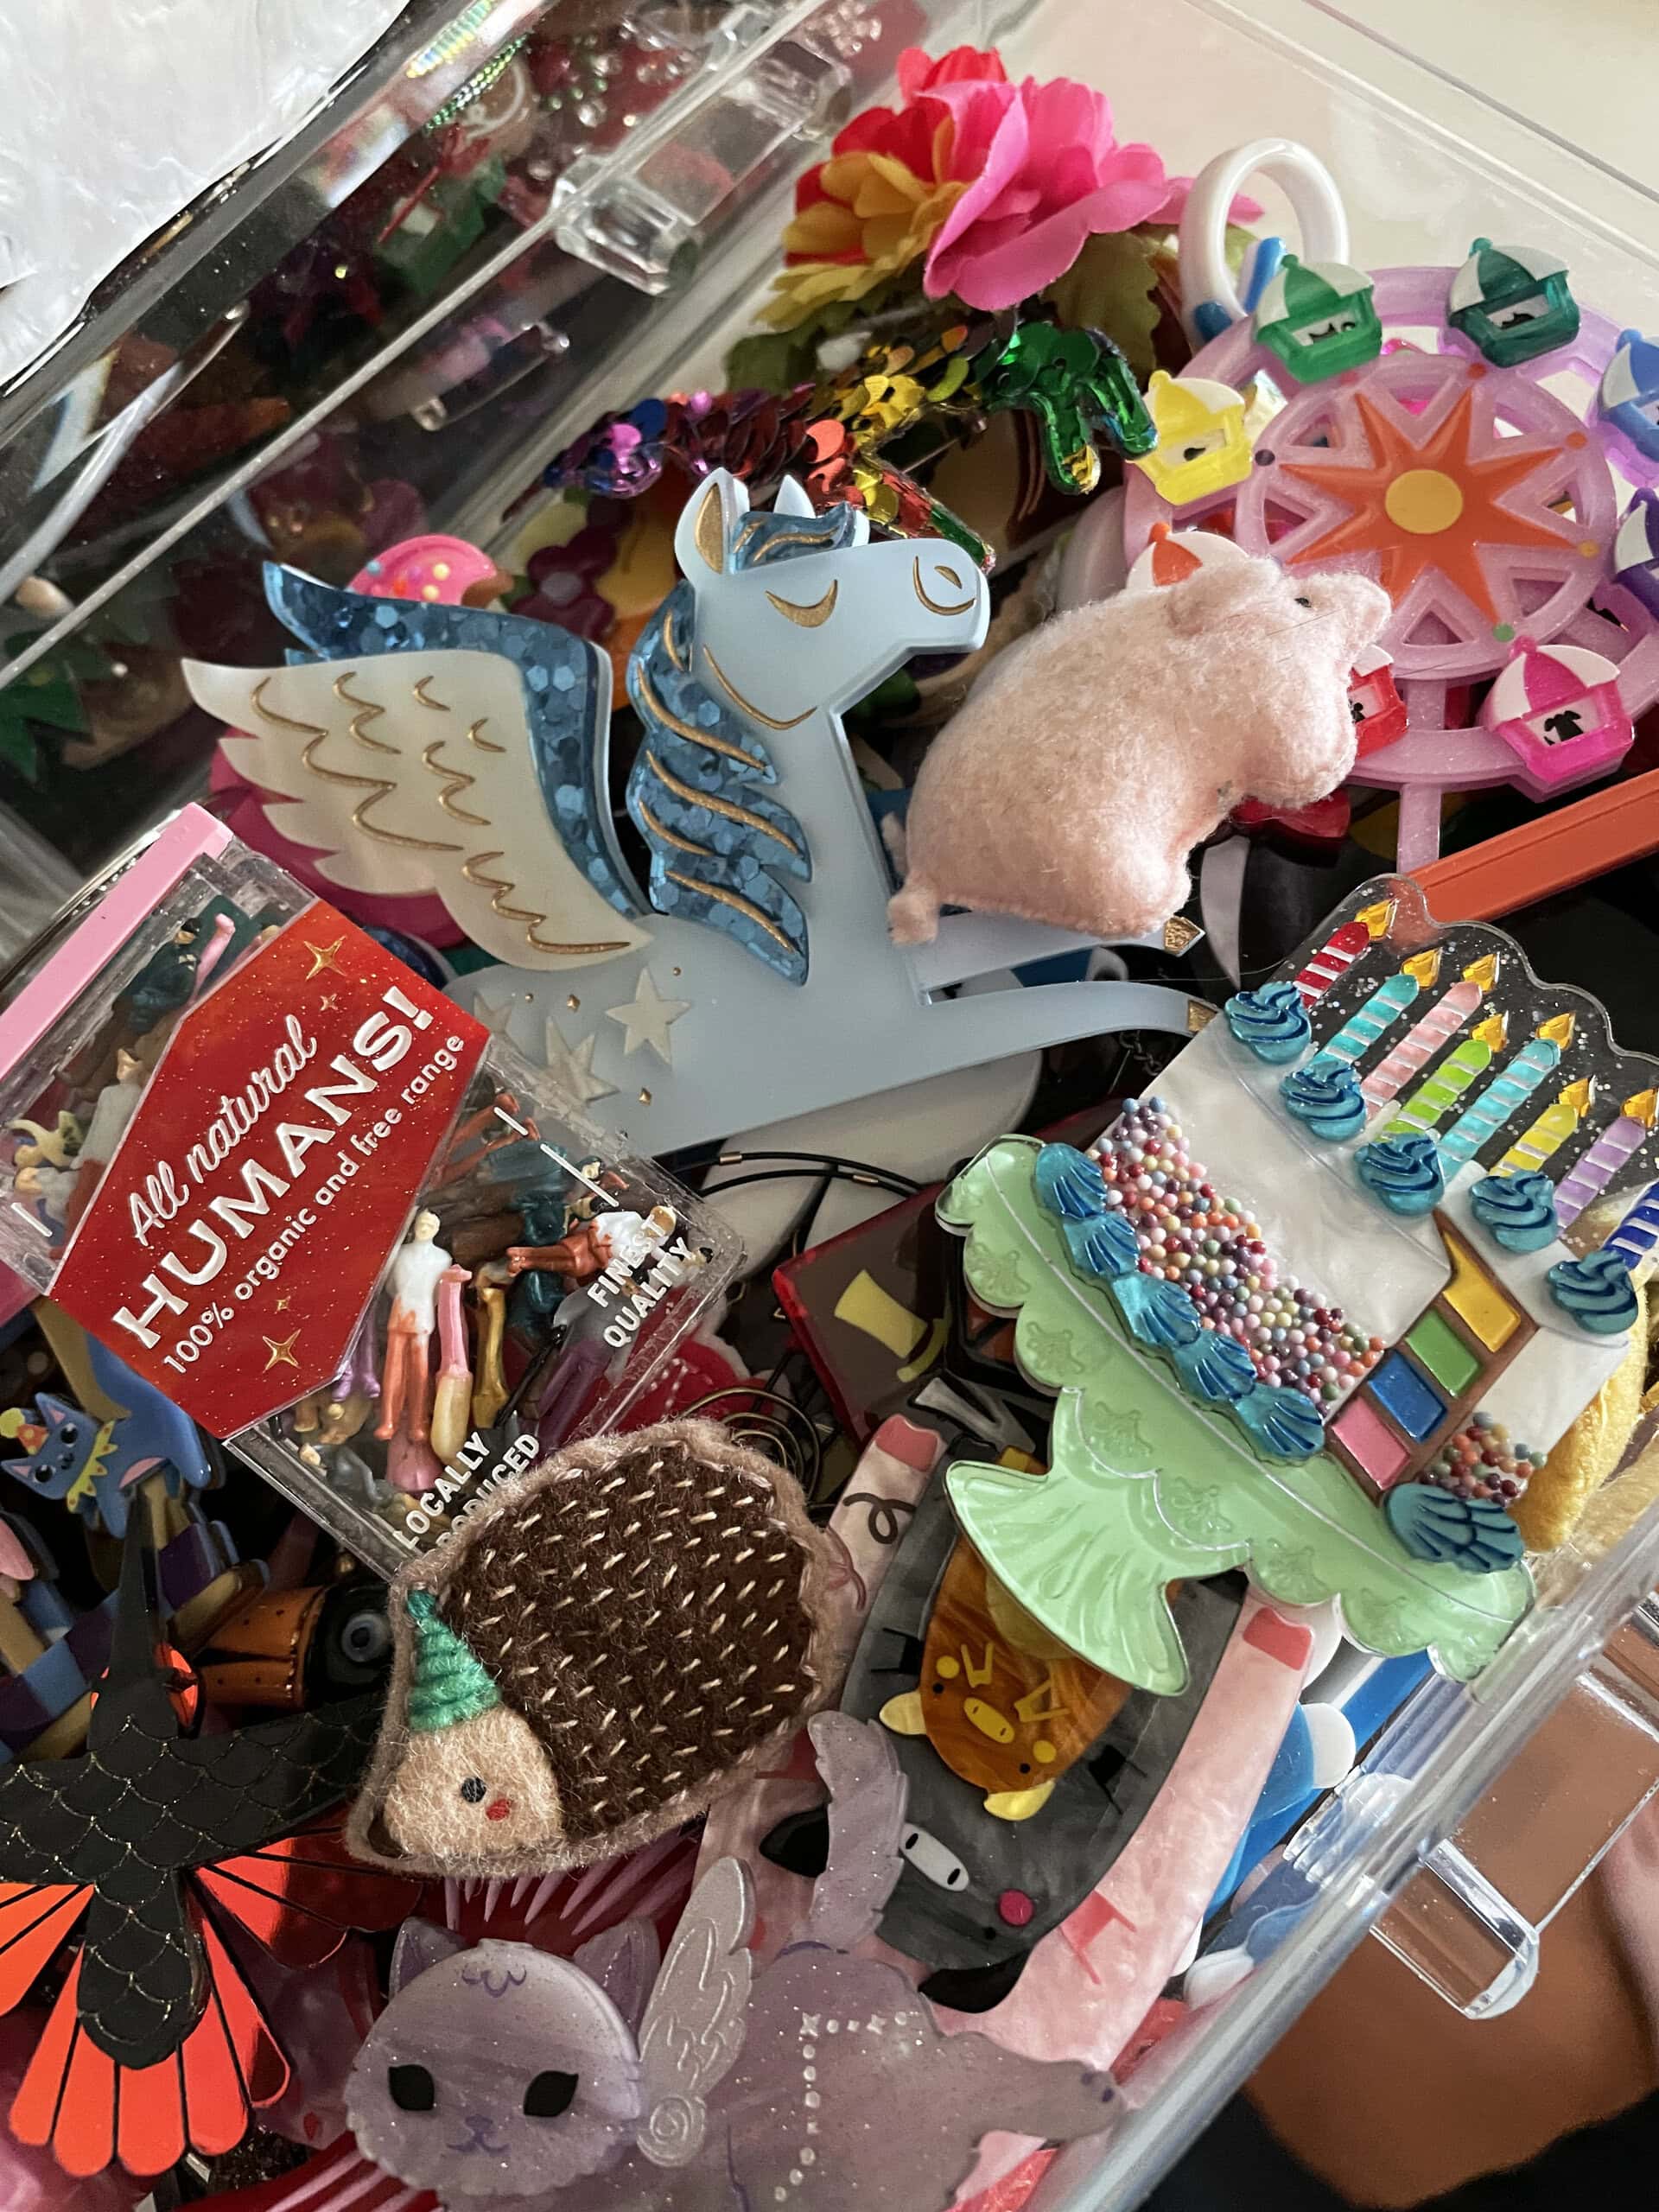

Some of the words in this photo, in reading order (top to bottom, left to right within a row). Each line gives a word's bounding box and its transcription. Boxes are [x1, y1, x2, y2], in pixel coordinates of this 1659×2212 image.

[112, 985, 434, 1350] HUMANS!
[128, 1160, 189, 1247] All
[187, 1014, 317, 1184] natural
[162, 1301, 235, 1374] 100%
[234, 1206, 317, 1301] organic
[315, 1152, 359, 1206] and
[351, 1107, 403, 1156] free
[400, 1034, 464, 1105] range
[587, 1214, 667, 1307] FINEST
[603, 1236, 692, 1348] QUALITY
[392, 1431, 490, 1550] LOCALLY
